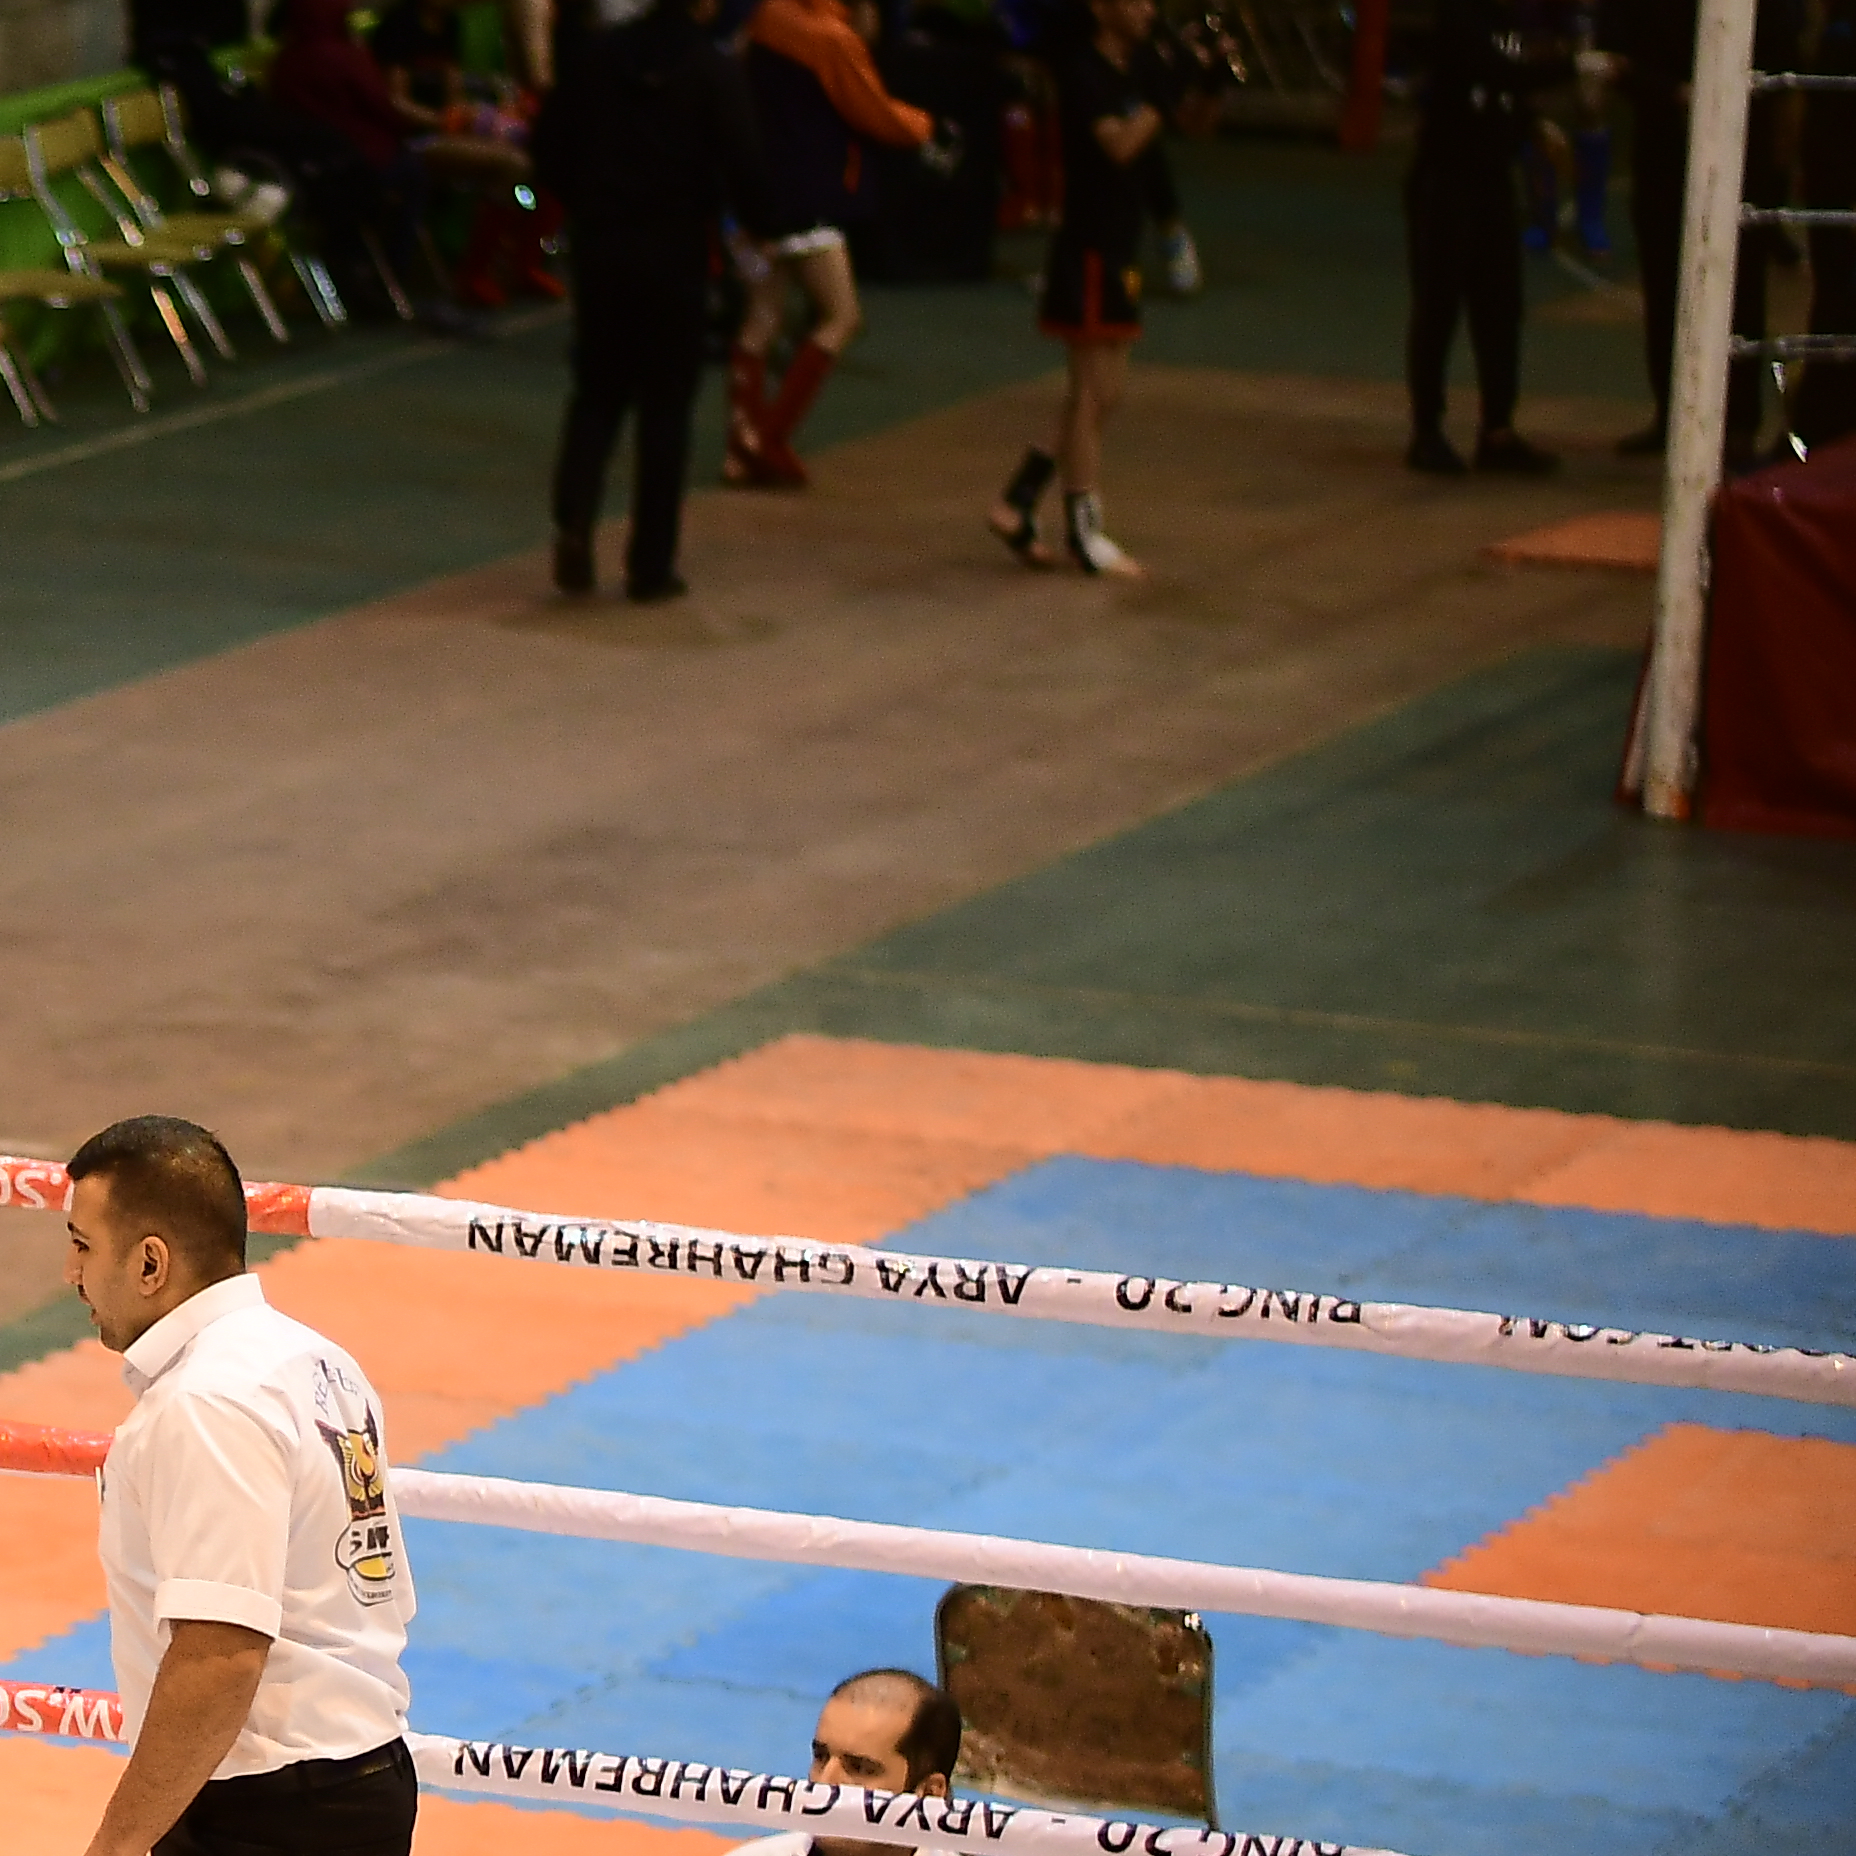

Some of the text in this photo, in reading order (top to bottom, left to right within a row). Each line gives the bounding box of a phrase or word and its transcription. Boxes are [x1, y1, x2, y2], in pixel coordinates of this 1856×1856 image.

[466, 1214, 855, 1287] GHAHREMAN
[874, 1258, 1036, 1307] ARYA
[454, 1739, 844, 1817] GHAHREMAN
[861, 1788, 1018, 1841] ARYA
